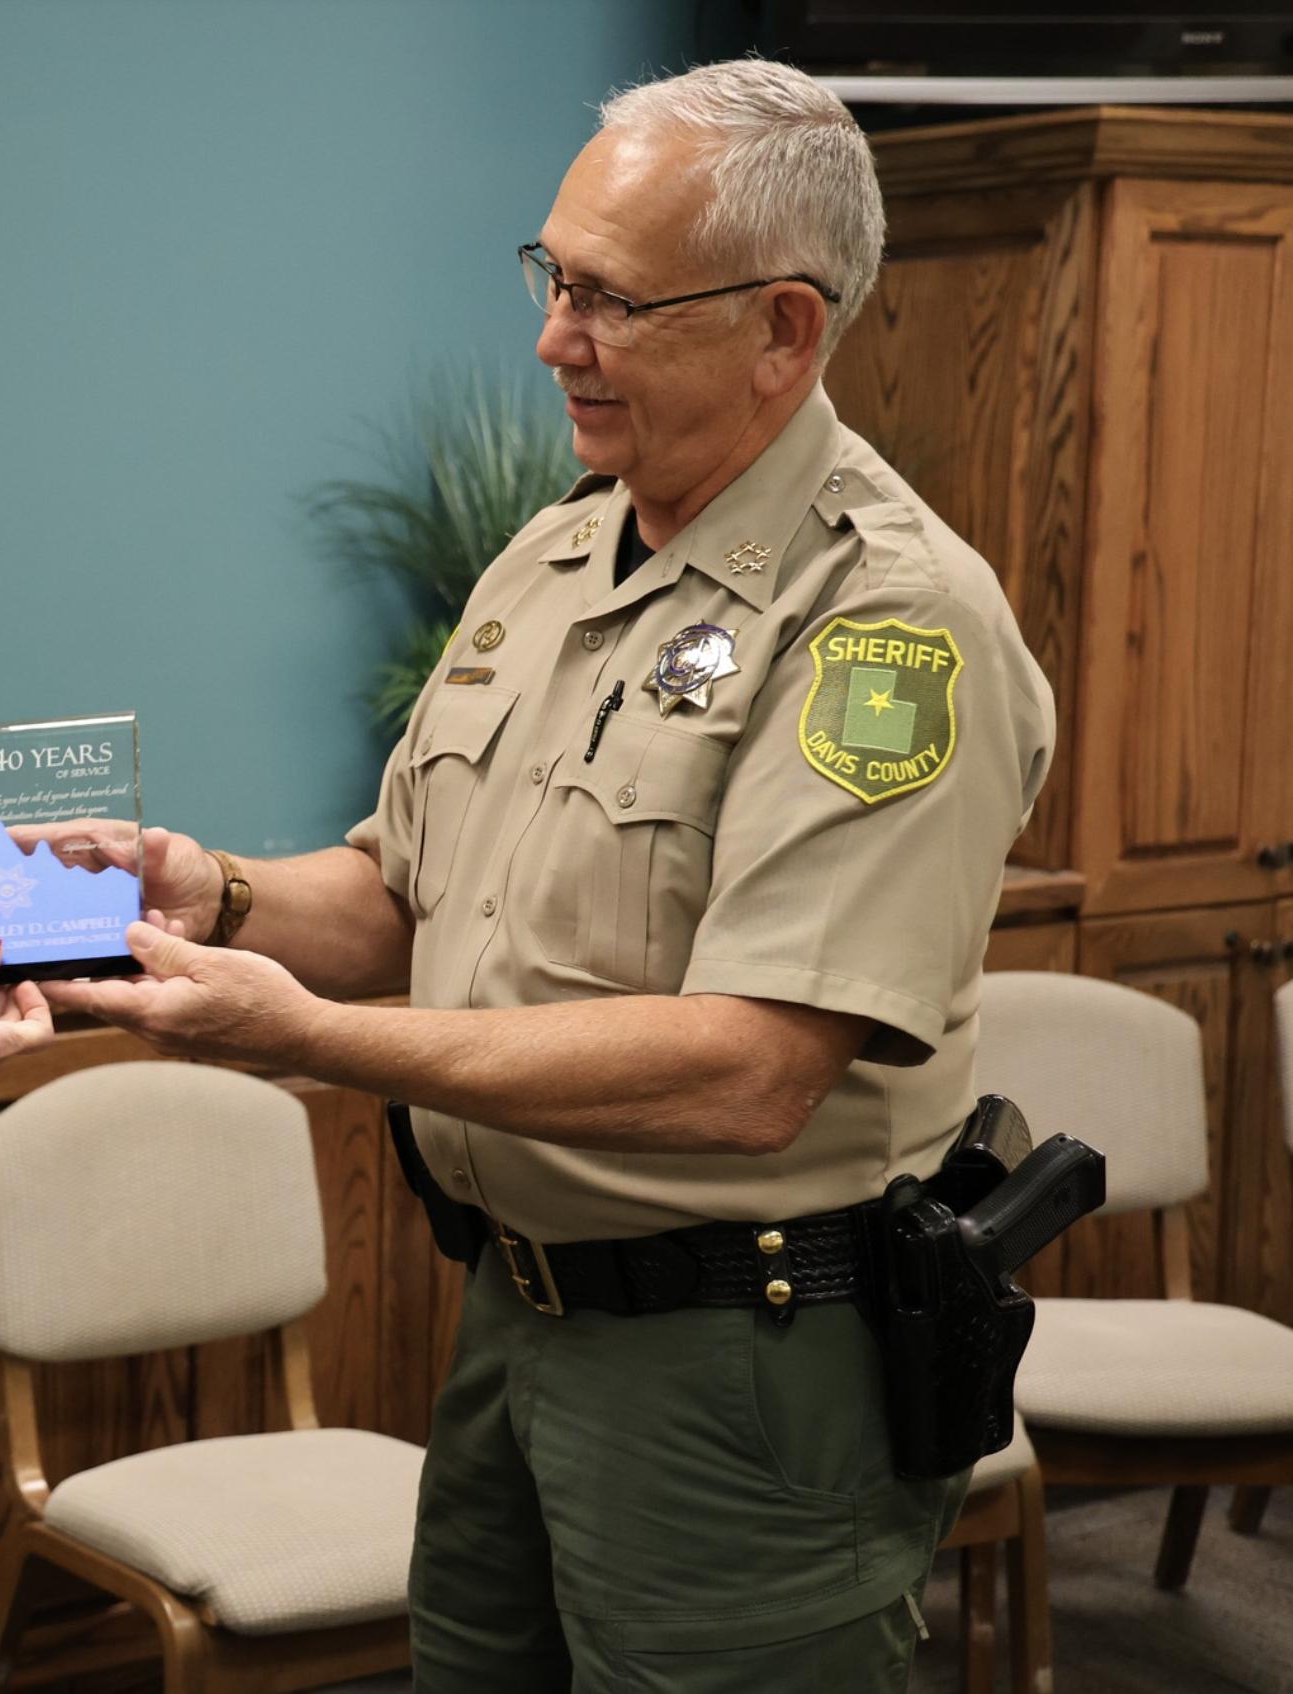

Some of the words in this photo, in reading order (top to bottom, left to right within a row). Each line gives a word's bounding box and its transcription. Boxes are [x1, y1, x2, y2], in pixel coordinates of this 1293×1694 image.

[825, 636, 951, 673] SHERIFF
[30, 742, 114, 769] YEARS
[807, 730, 860, 775] DAVIS
[866, 743, 940, 783] COUNTY
[55, 769, 68, 779] OF
[70, 766, 110, 778] SERVICE
[1, 797, 18, 809] you
[17, 792, 31, 806] for
[49, 791, 69, 806] your
[70, 786, 93, 799] hard
[91, 785, 112, 797] work
[47, 915, 122, 932] CAMPBELL
